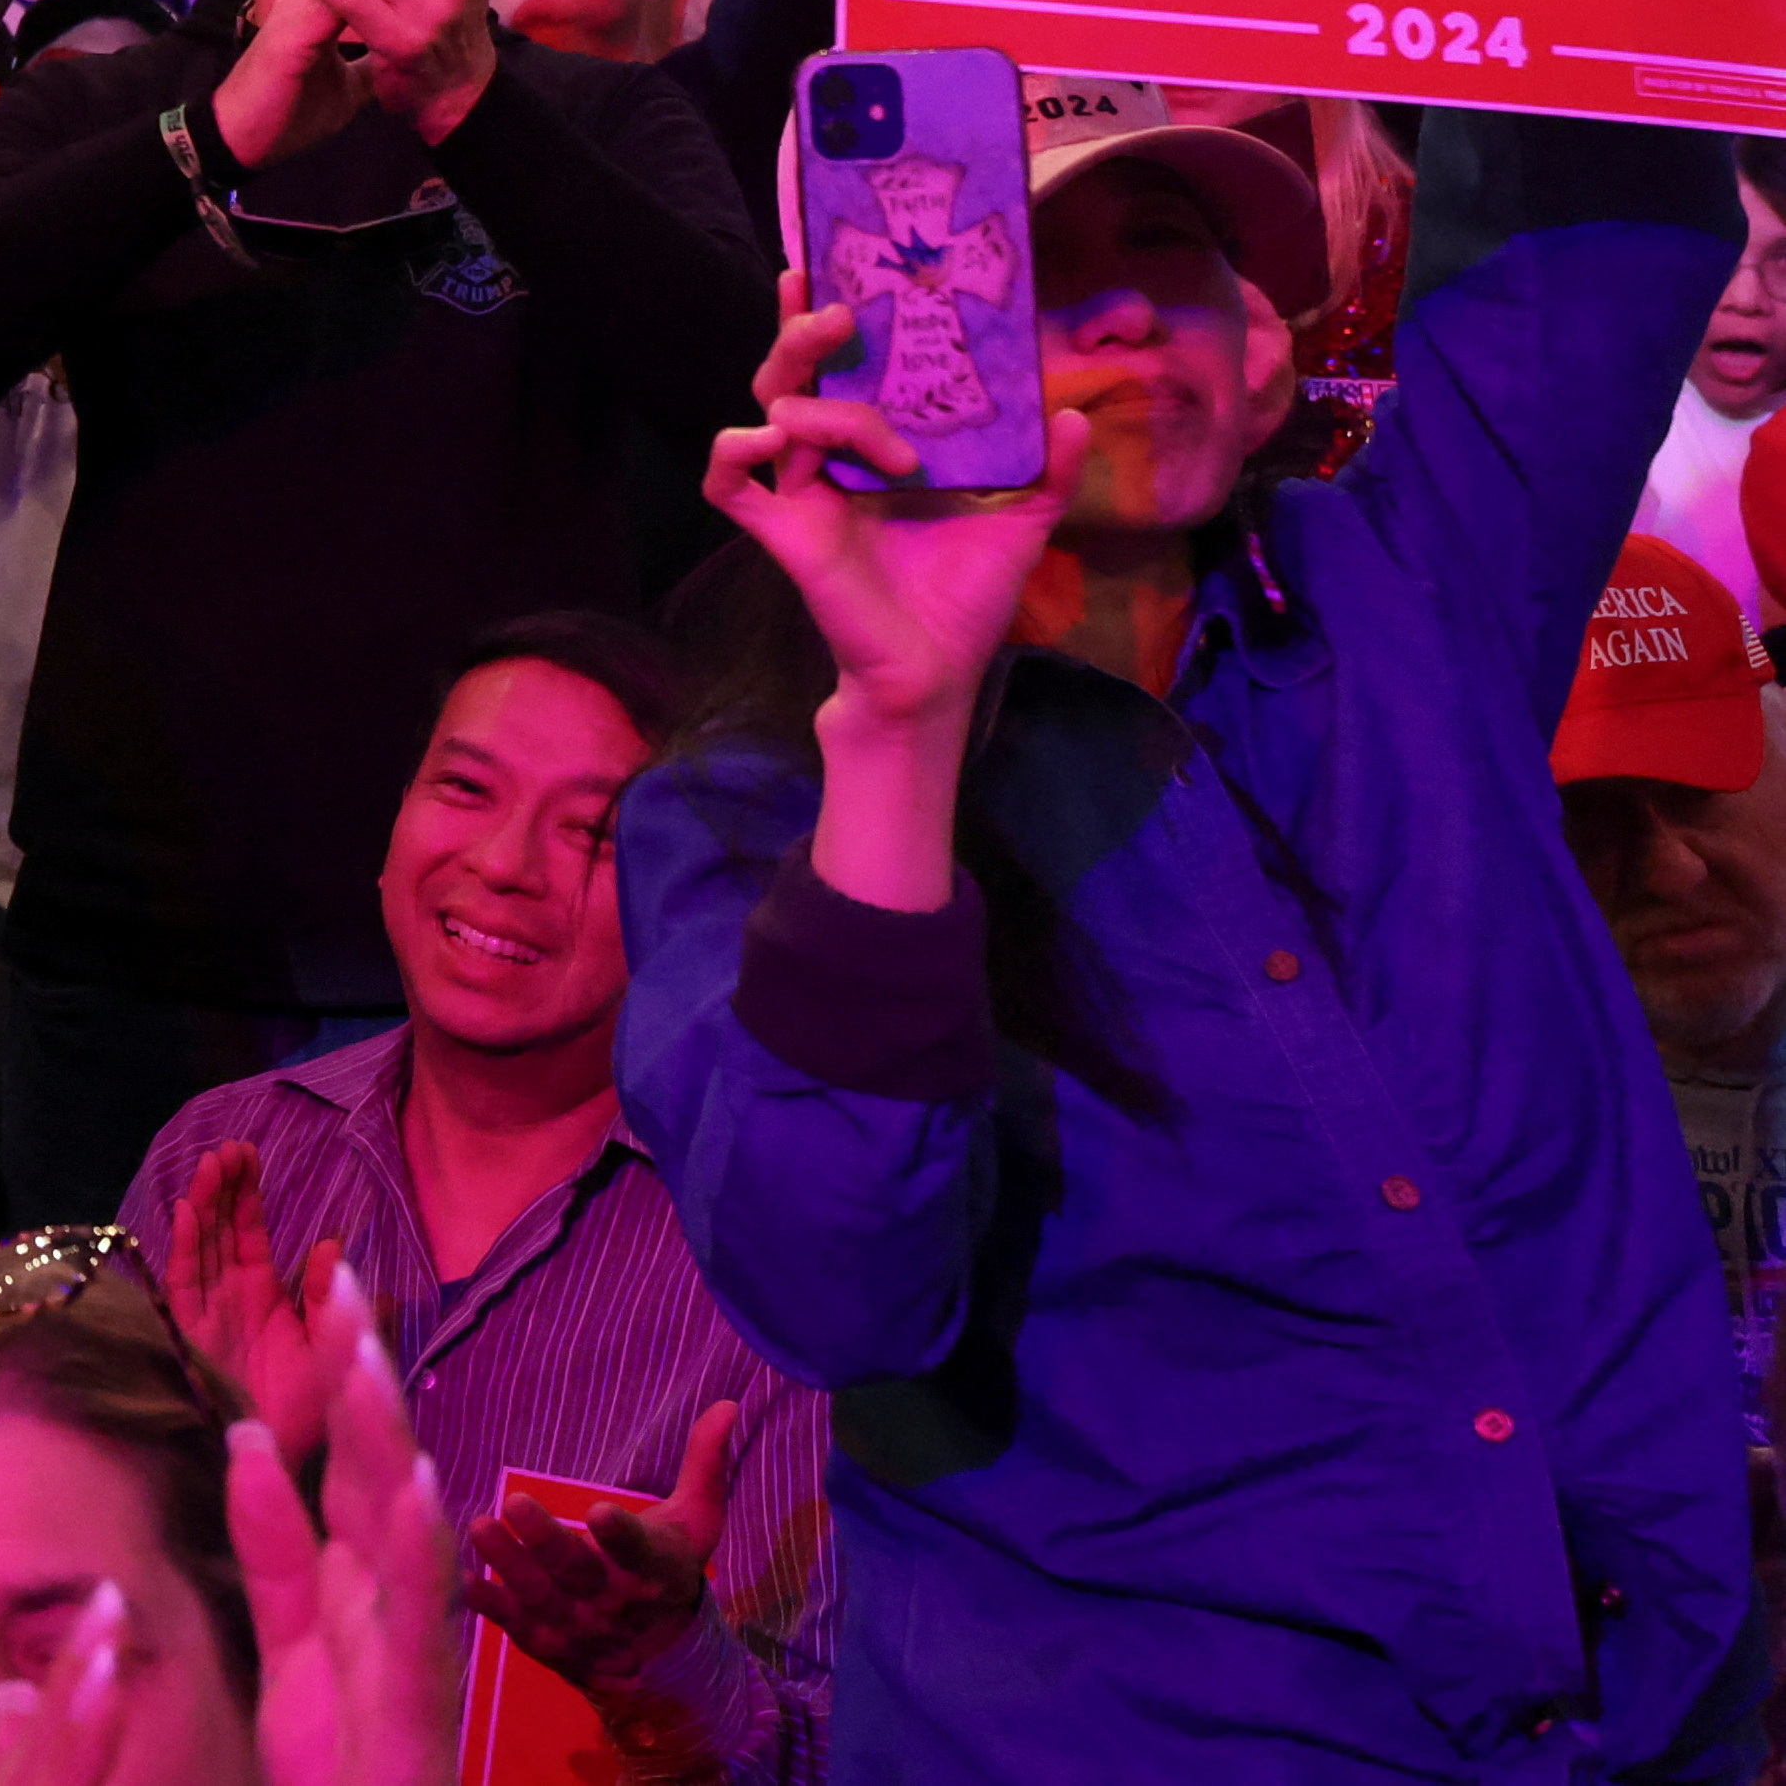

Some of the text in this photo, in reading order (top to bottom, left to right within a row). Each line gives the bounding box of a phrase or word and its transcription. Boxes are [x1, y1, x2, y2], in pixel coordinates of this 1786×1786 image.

[1346, 4, 1527, 68] 2024
[1027, 96, 1118, 123] 2024
[1592, 587, 1688, 619] ERICA
[1590, 627, 1689, 671] AGAIN
